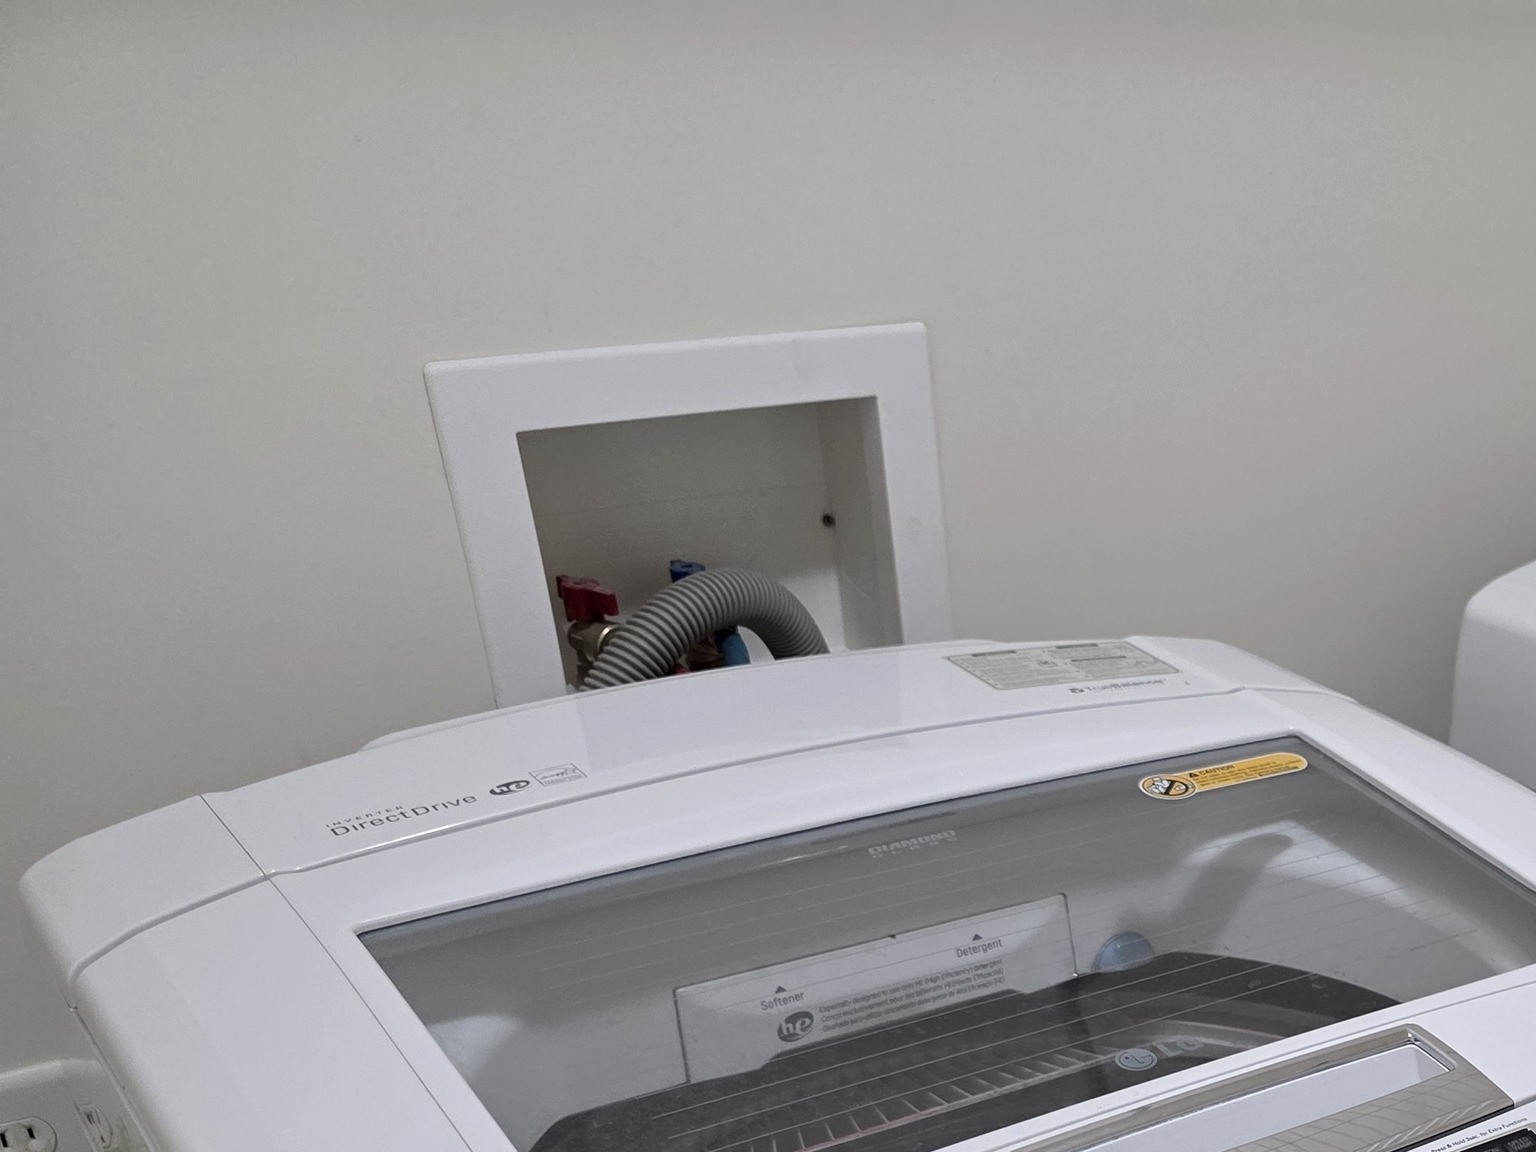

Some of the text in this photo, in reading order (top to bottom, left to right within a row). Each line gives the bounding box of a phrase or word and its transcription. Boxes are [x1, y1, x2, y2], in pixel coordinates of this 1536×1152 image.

[326, 805, 404, 828] INVERTER
[956, 938, 1003, 959] Detergent
[760, 991, 805, 1012] Softener
[1488, 1126, 1502, 1134] Extra
